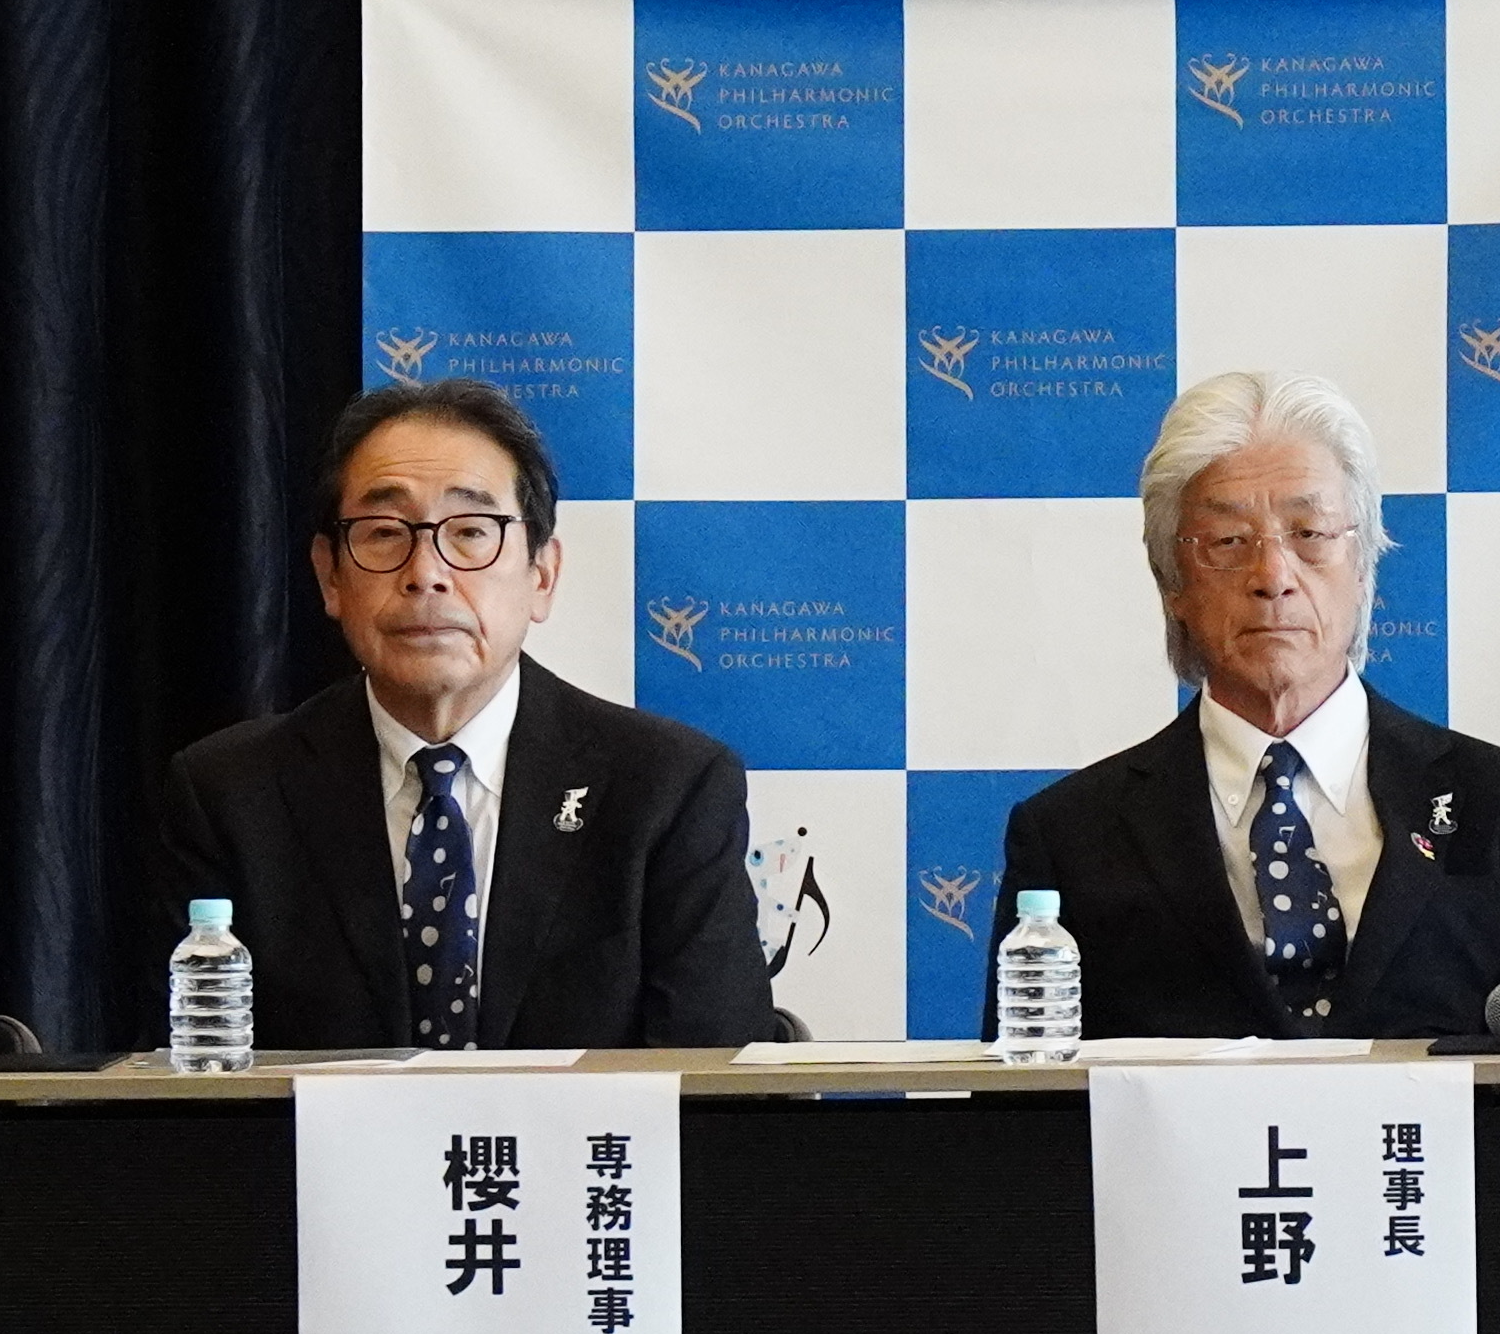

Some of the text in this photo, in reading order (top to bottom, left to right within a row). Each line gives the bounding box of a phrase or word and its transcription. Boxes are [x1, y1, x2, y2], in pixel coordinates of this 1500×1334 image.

[719, 63, 844, 78] KANAGAWA
[1261, 58, 1386, 73] KANAGAWA
[719, 88, 895, 104] PHILHARMONIC
[1261, 82, 1437, 99] PHILHARMONIC
[719, 115, 850, 130] ORCHESTRA
[1261, 109, 1392, 125] ORCHESTRA
[449, 333, 574, 347] KANAGAWA
[991, 331, 1116, 346] KANAGAWA
[449, 358, 625, 373] PHILHARMONIC
[991, 356, 1167, 372] PHILHARMONIC
[506, 384, 580, 399] ESTRA
[991, 383, 1122, 398] ORCHESTRA
[720, 602, 845, 617] KANAGAWA
[720, 627, 896, 643] PHILHARMONIC
[720, 654, 851, 669] ORCHESTRA
[1382, 1123, 1425, 1257] 理事長
[1238, 1125, 1316, 1285] 上野
[443, 1134, 521, 1296] 櫻井
[586, 1133, 634, 1334] 専務理事
